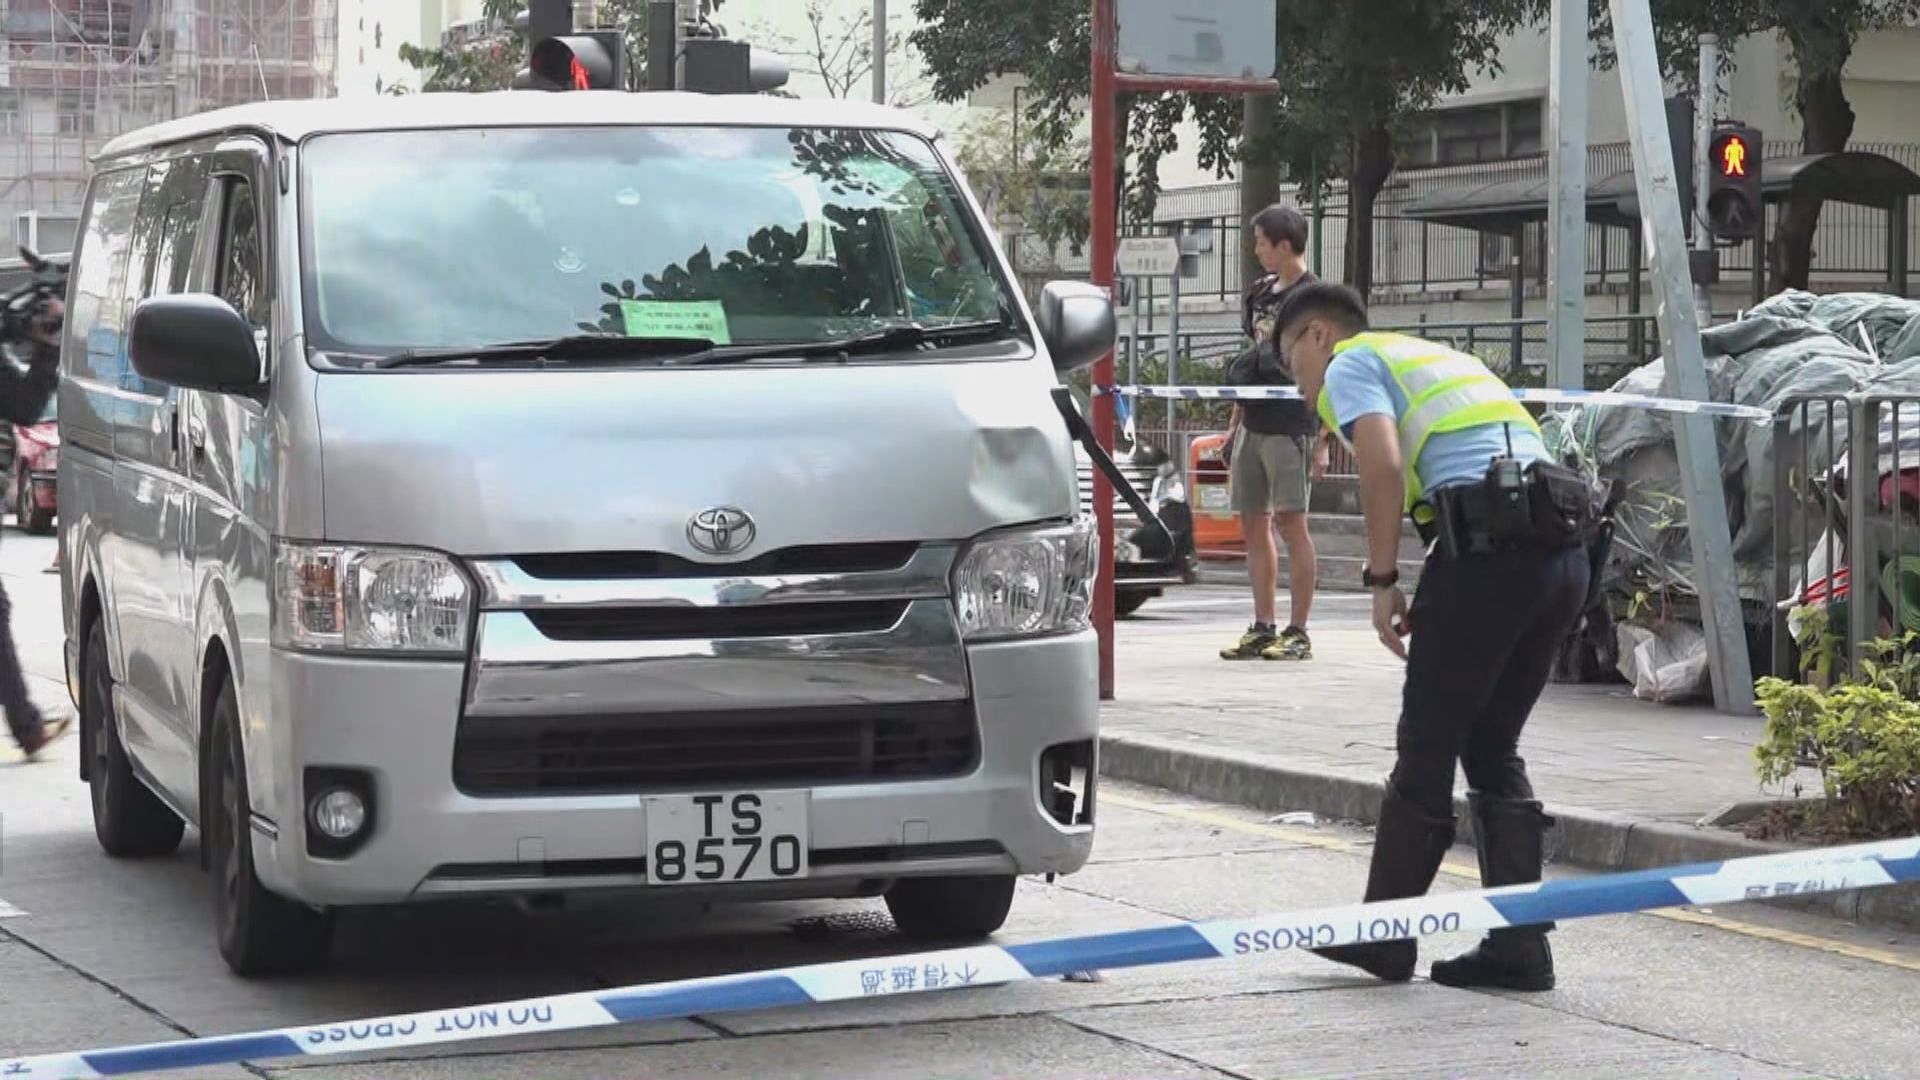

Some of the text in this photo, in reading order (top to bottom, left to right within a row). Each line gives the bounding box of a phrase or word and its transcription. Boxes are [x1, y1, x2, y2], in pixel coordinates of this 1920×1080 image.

[693, 794, 761, 836] TS
[655, 834, 800, 881] 8570
[1233, 912, 1460, 955] DO NOT CROSS
[860, 960, 980, 995] 不得越過
